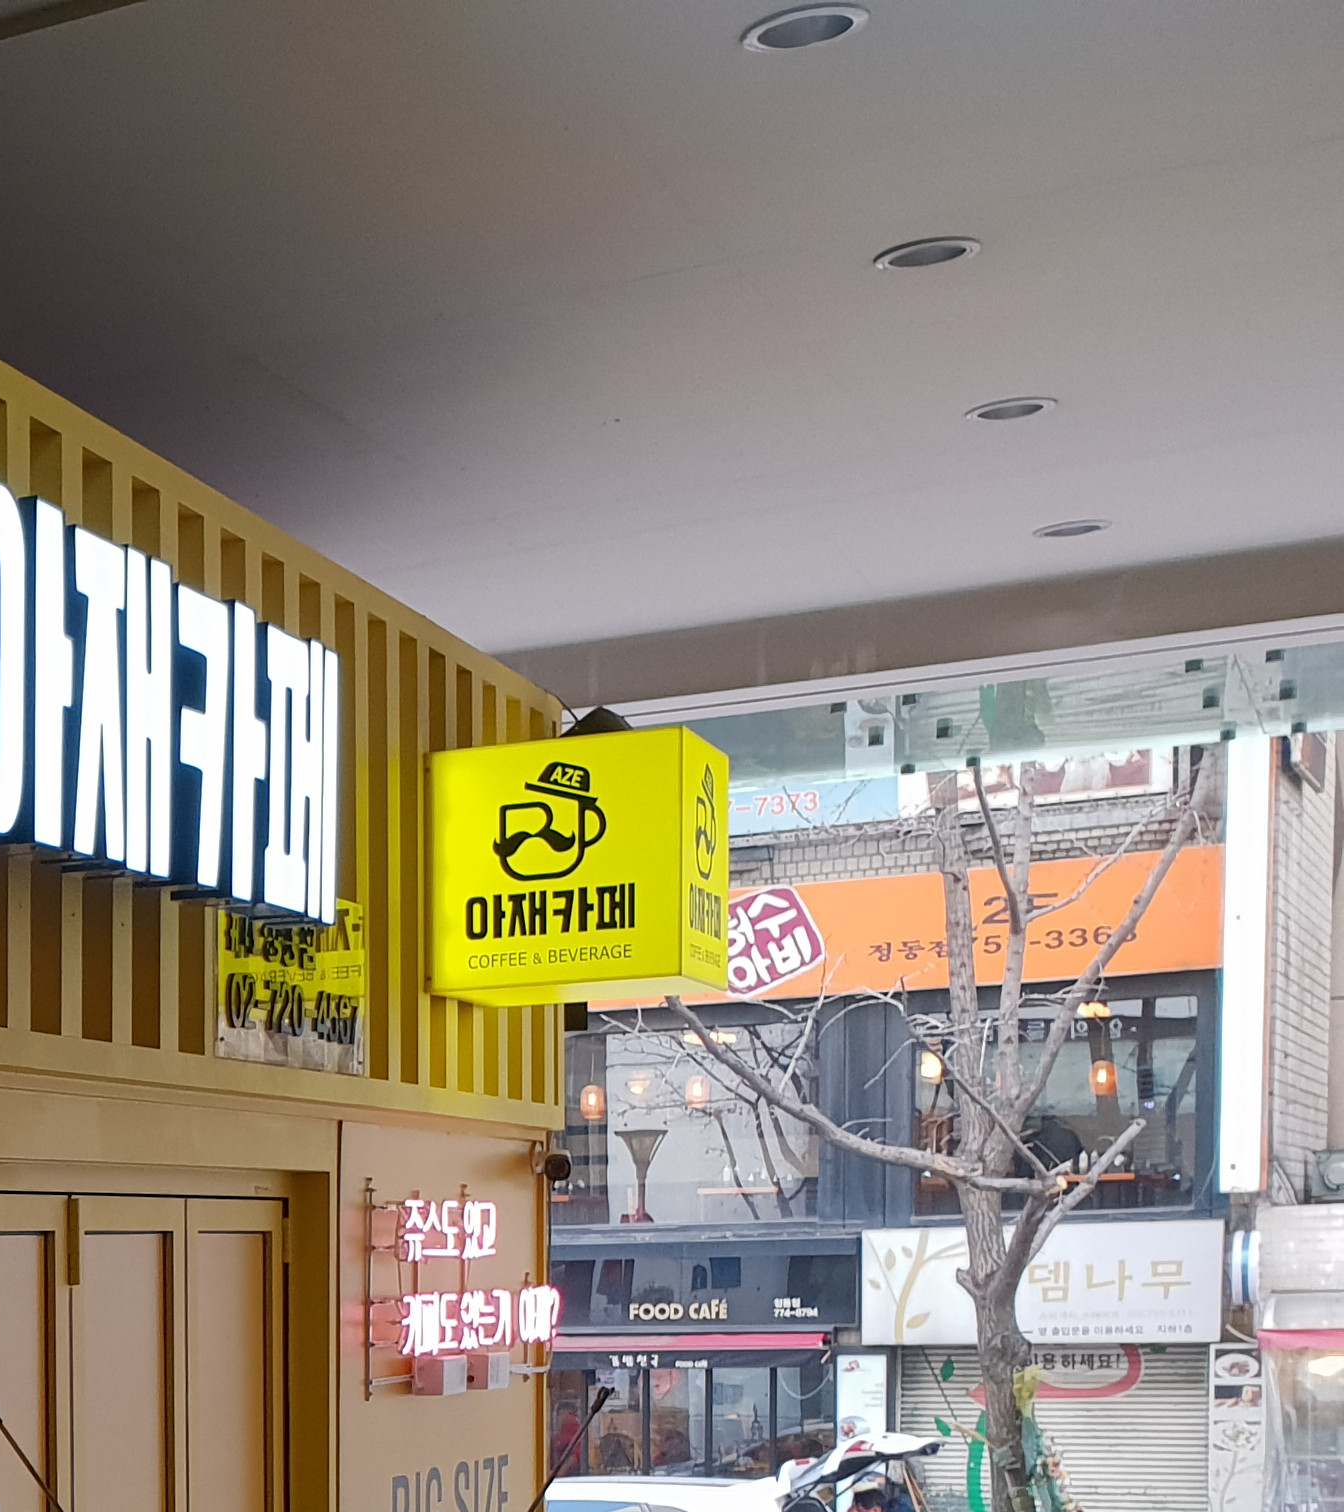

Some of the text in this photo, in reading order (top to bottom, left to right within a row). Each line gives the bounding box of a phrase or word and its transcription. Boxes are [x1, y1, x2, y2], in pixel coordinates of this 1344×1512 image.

[549, 765, 585, 788] AZE
[466, 882, 636, 941] 아재카페
[689, 882, 723, 942] 아재카페
[972, 925, 1138, 956] 5-336
[468, 951, 527, 970] COFFEE
[548, 944, 634, 965] BEVERAGE
[628, 1299, 728, 1321] FOOD CAFÉ
